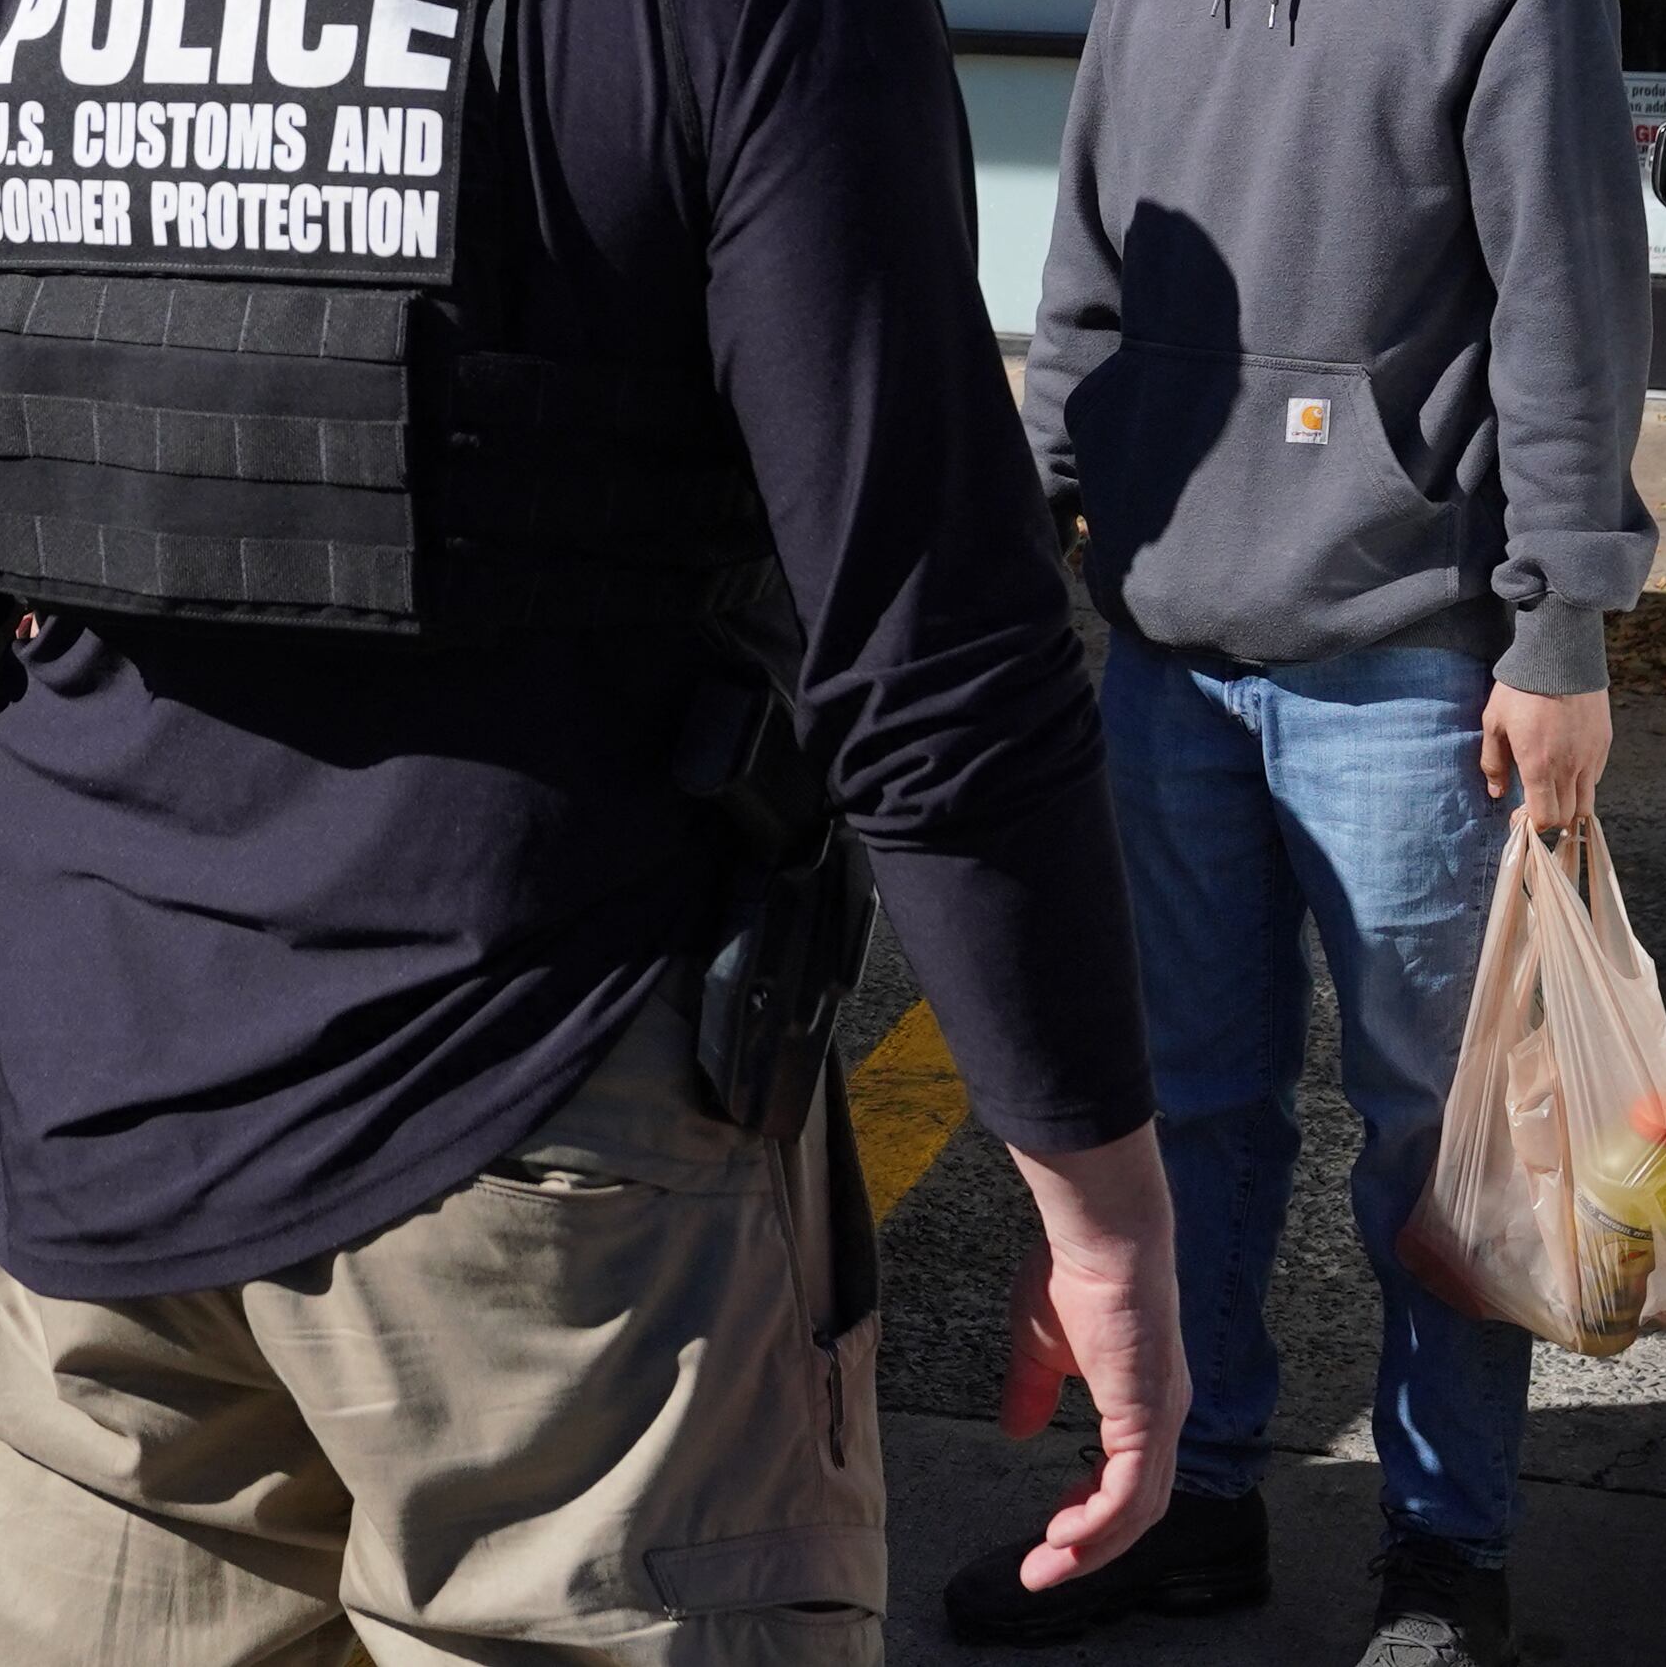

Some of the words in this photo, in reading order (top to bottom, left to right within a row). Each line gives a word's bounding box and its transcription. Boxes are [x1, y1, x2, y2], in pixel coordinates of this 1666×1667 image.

[73, 101, 308, 173] CUSTOMS
[327, 105, 444, 178] AND
[150, 181, 440, 259] PROTECTION
